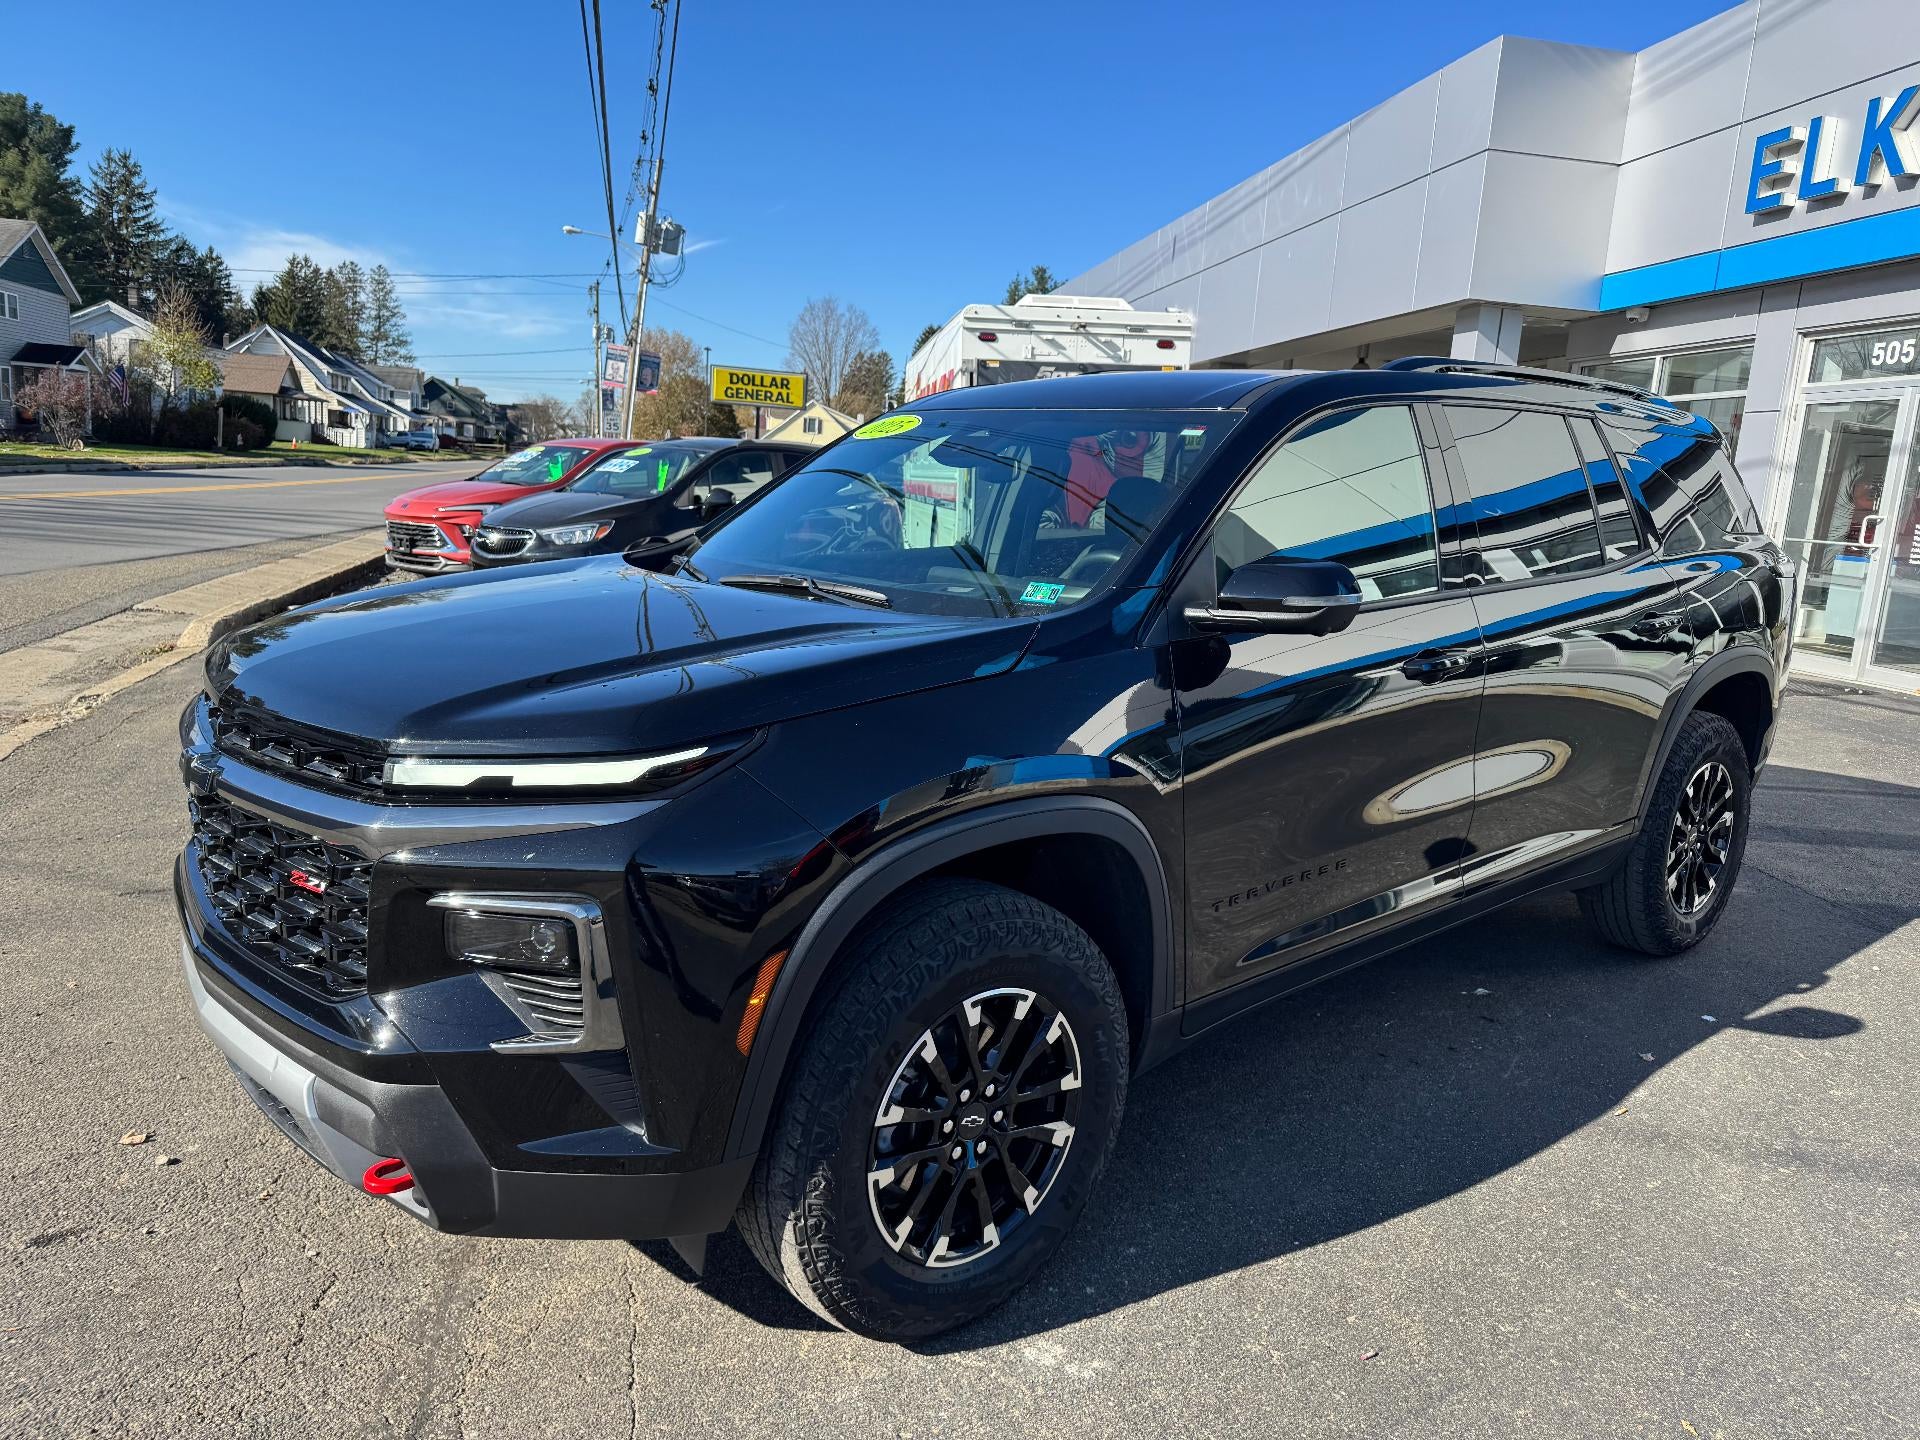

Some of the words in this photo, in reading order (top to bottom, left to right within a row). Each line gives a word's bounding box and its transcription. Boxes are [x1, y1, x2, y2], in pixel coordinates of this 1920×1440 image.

[1871, 338, 1916, 366] 505
[729, 372, 790, 390] DOLLAR
[724, 386, 794, 404] GENERAL
[606, 422, 620, 431] 35
[1211, 858, 1348, 912] TRAVERSE
